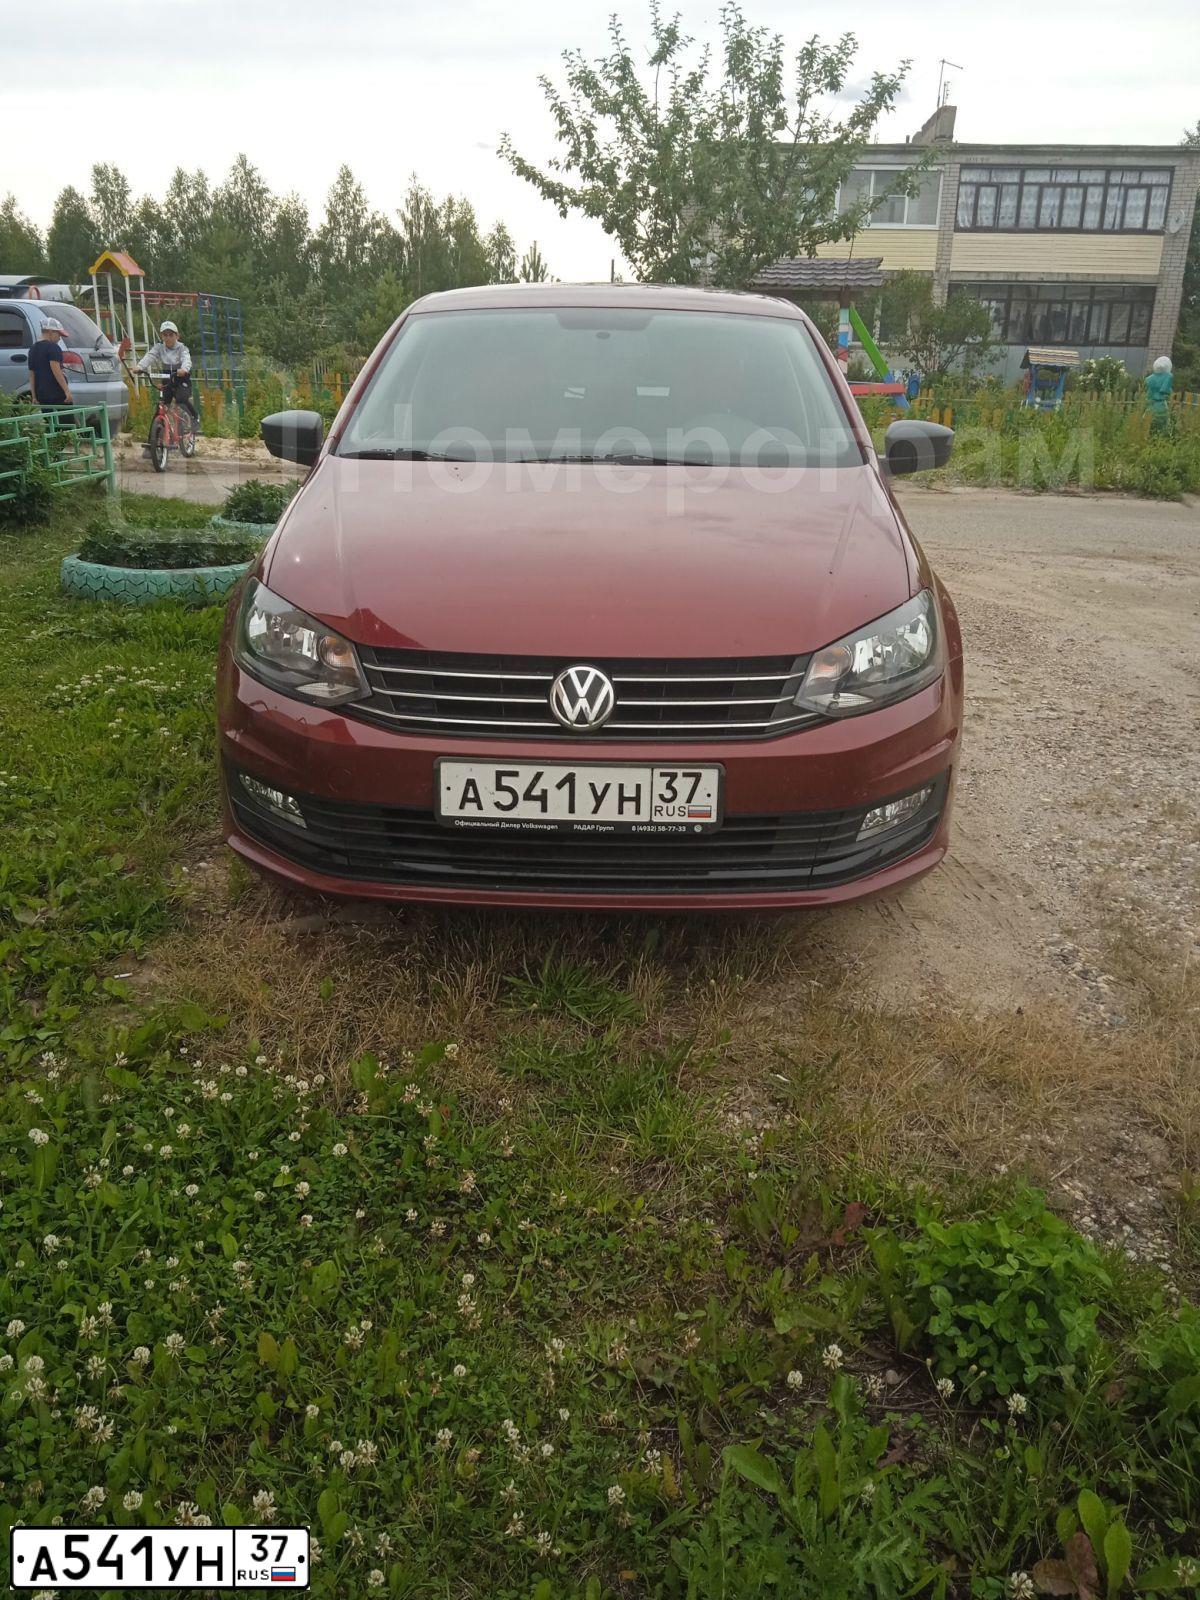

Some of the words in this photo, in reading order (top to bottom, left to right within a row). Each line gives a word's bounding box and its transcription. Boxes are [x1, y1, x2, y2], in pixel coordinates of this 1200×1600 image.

[458, 769, 642, 815] А541УН
[658, 771, 703, 804] 37
[654, 805, 687, 817] RUS
[454, 819, 500, 828] Официальный
[500, 821, 521, 829] Дилер
[521, 822, 559, 831] Volkswagen
